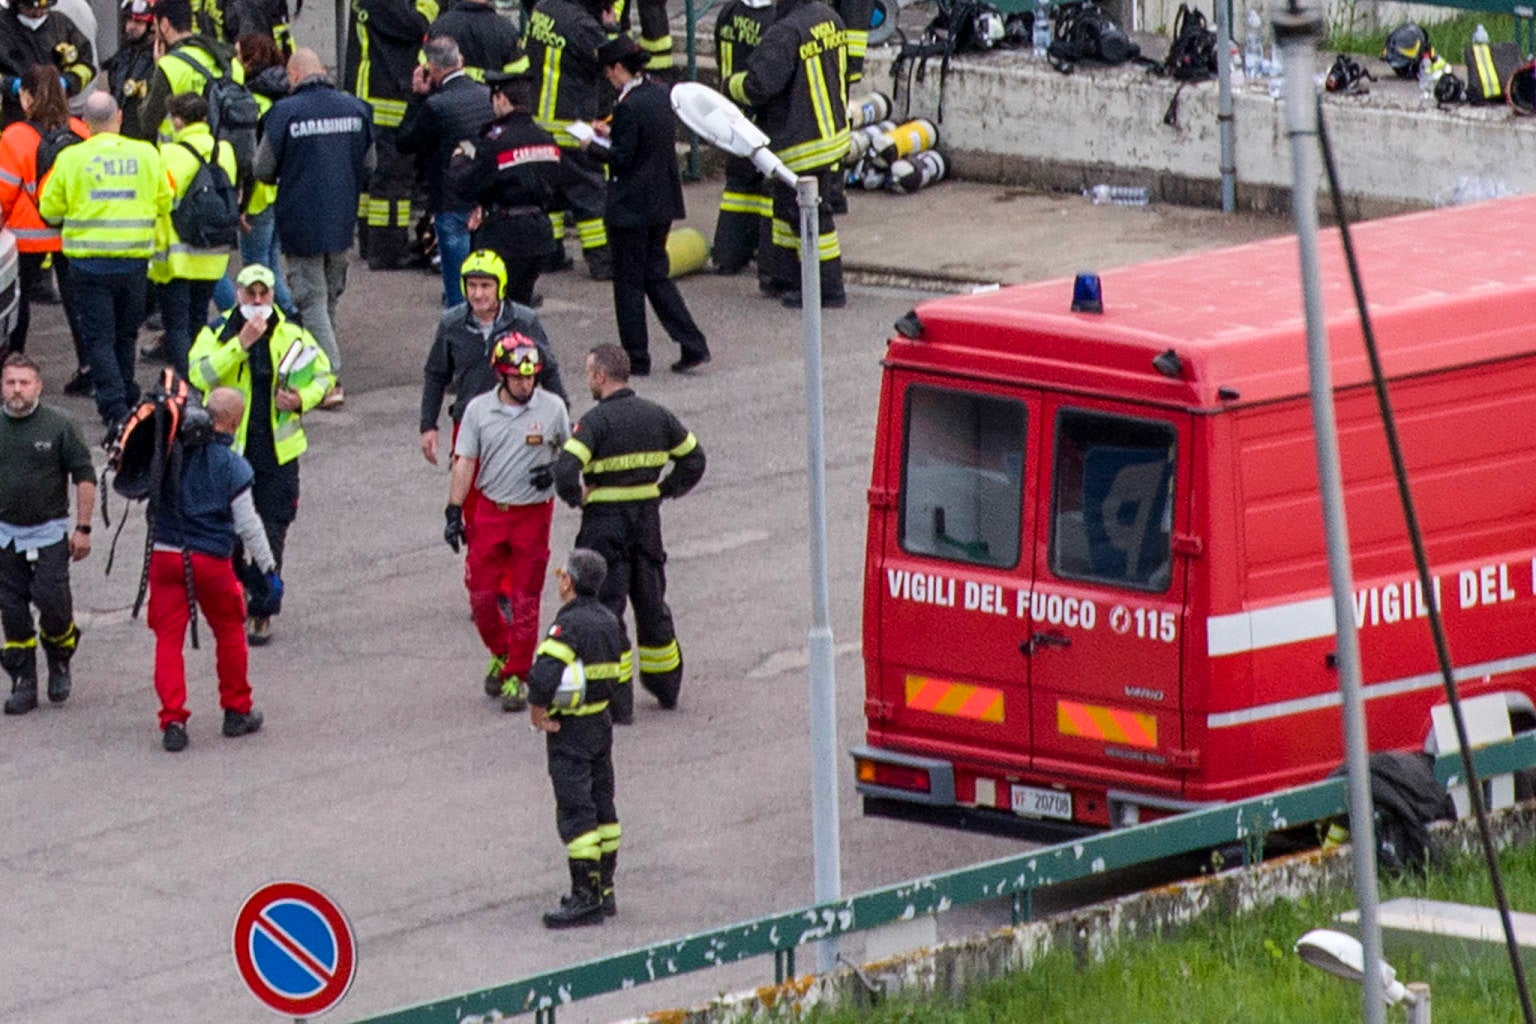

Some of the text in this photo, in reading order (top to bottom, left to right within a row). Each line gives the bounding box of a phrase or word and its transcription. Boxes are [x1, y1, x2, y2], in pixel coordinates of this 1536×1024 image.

[888, 568, 1176, 643] VIGILI DEL FUOCO 115
[1352, 576, 1442, 630] VIGILI
[1459, 563, 1516, 610] DEL
